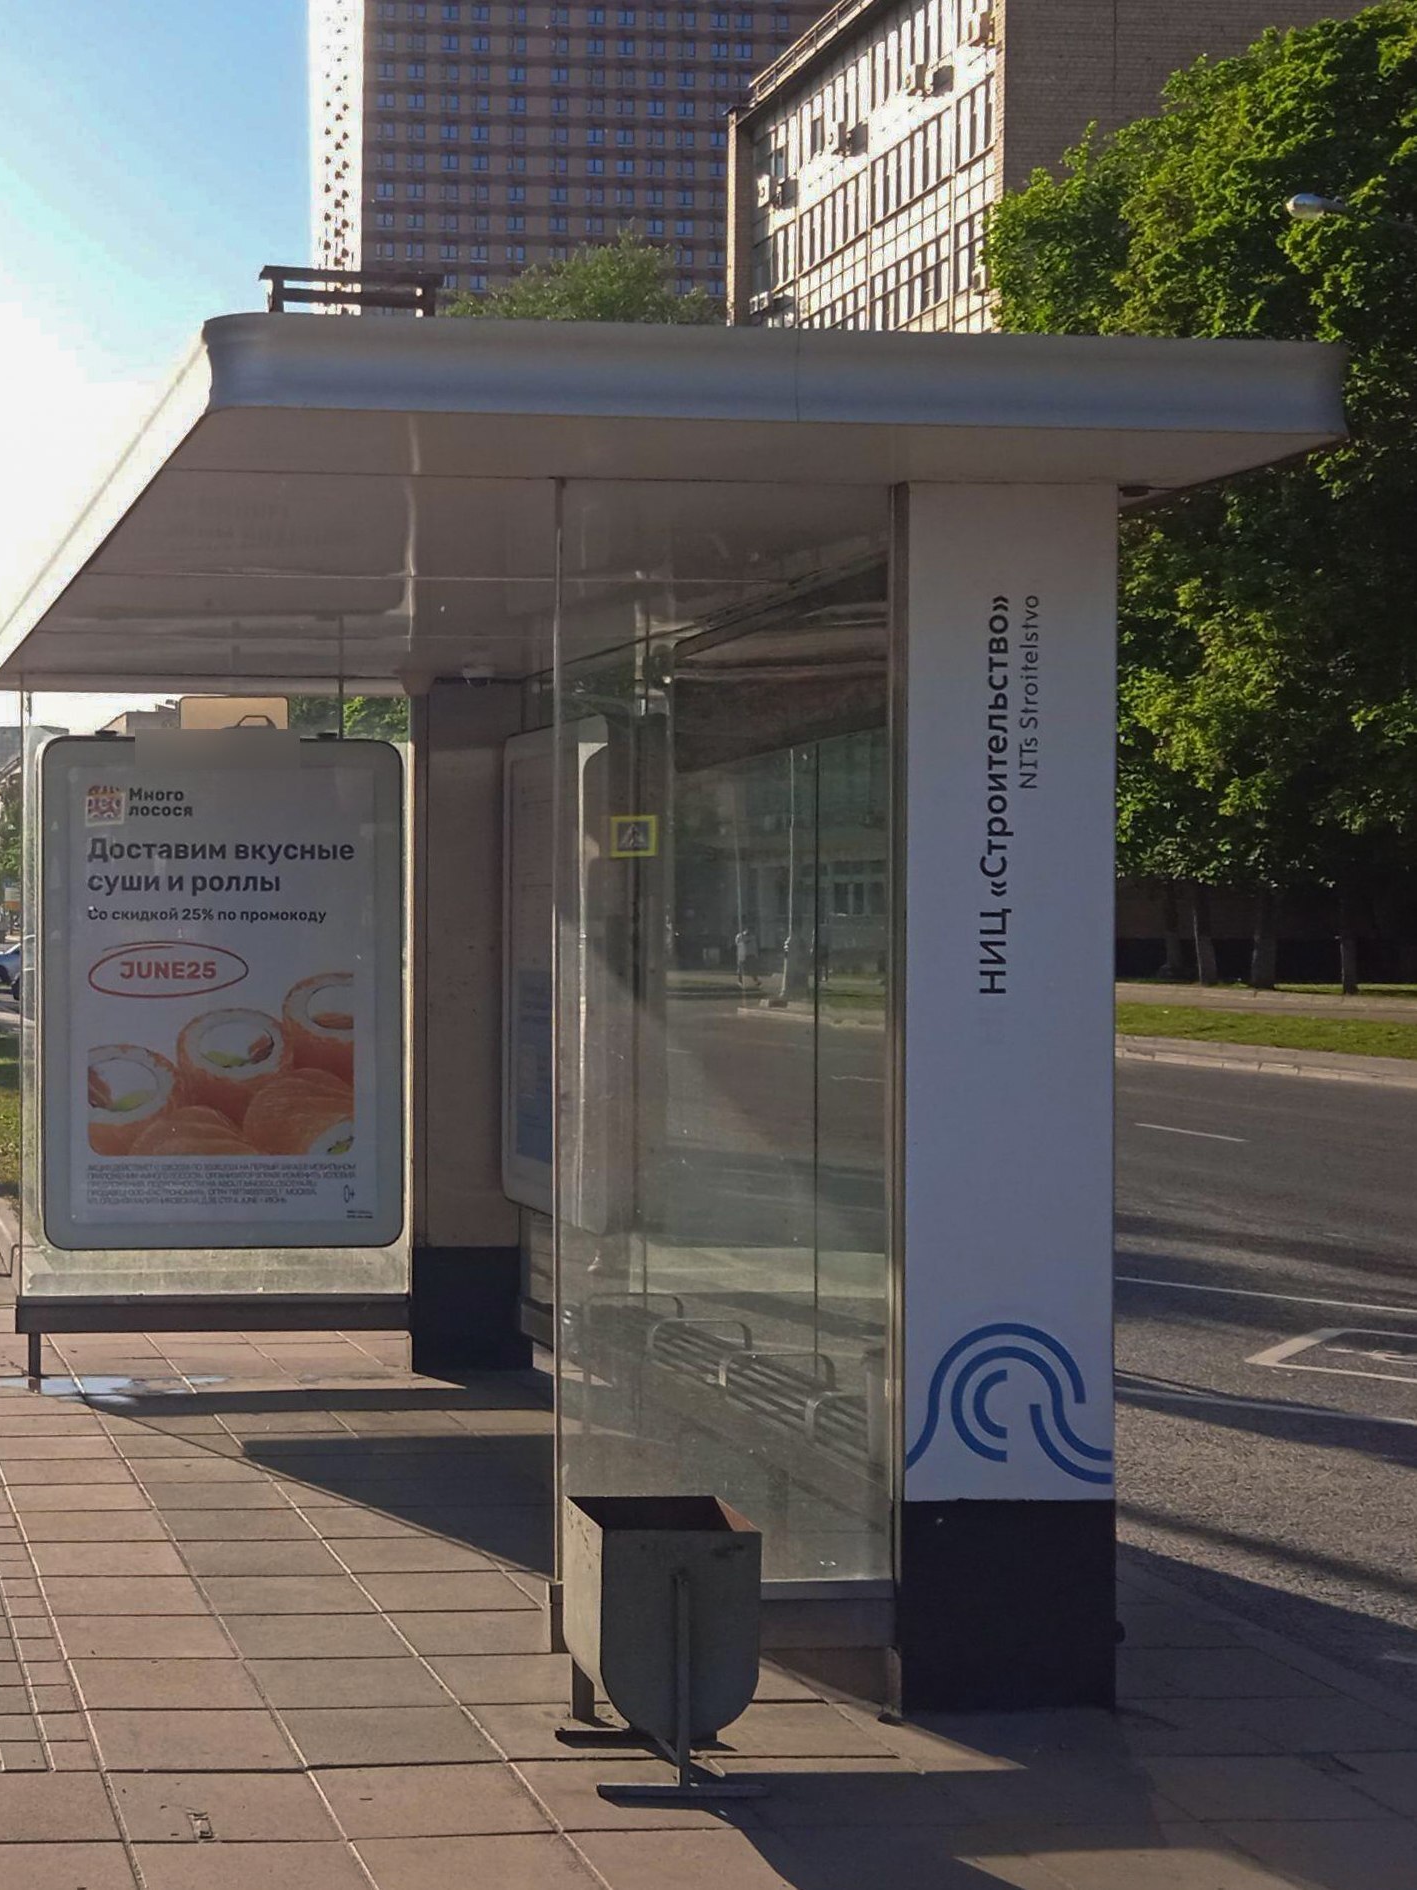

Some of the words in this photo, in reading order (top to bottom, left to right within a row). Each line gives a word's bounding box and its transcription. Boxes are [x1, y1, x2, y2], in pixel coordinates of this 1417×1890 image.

[1019, 595, 1040, 729] Stroitelstvo
[979, 595, 1014, 897] «Строительство»
[1019, 736, 1039, 789] NITs
[129, 787, 185, 802] Много
[128, 804, 194, 817] лосося
[88, 837, 227, 863] Доставим
[234, 842, 356, 866] вкусные
[87, 874, 161, 897] суши
[167, 875, 184, 892] и
[191, 874, 281, 898] роллы
[87, 908, 108, 922] Со
[111, 907, 179, 923] скидкой
[181, 908, 215, 922] 25%
[217, 910, 237, 922] по
[240, 910, 328, 925] промокоду
[979, 908, 1012, 995] НИЦ
[119, 960, 217, 981] JUNE25
